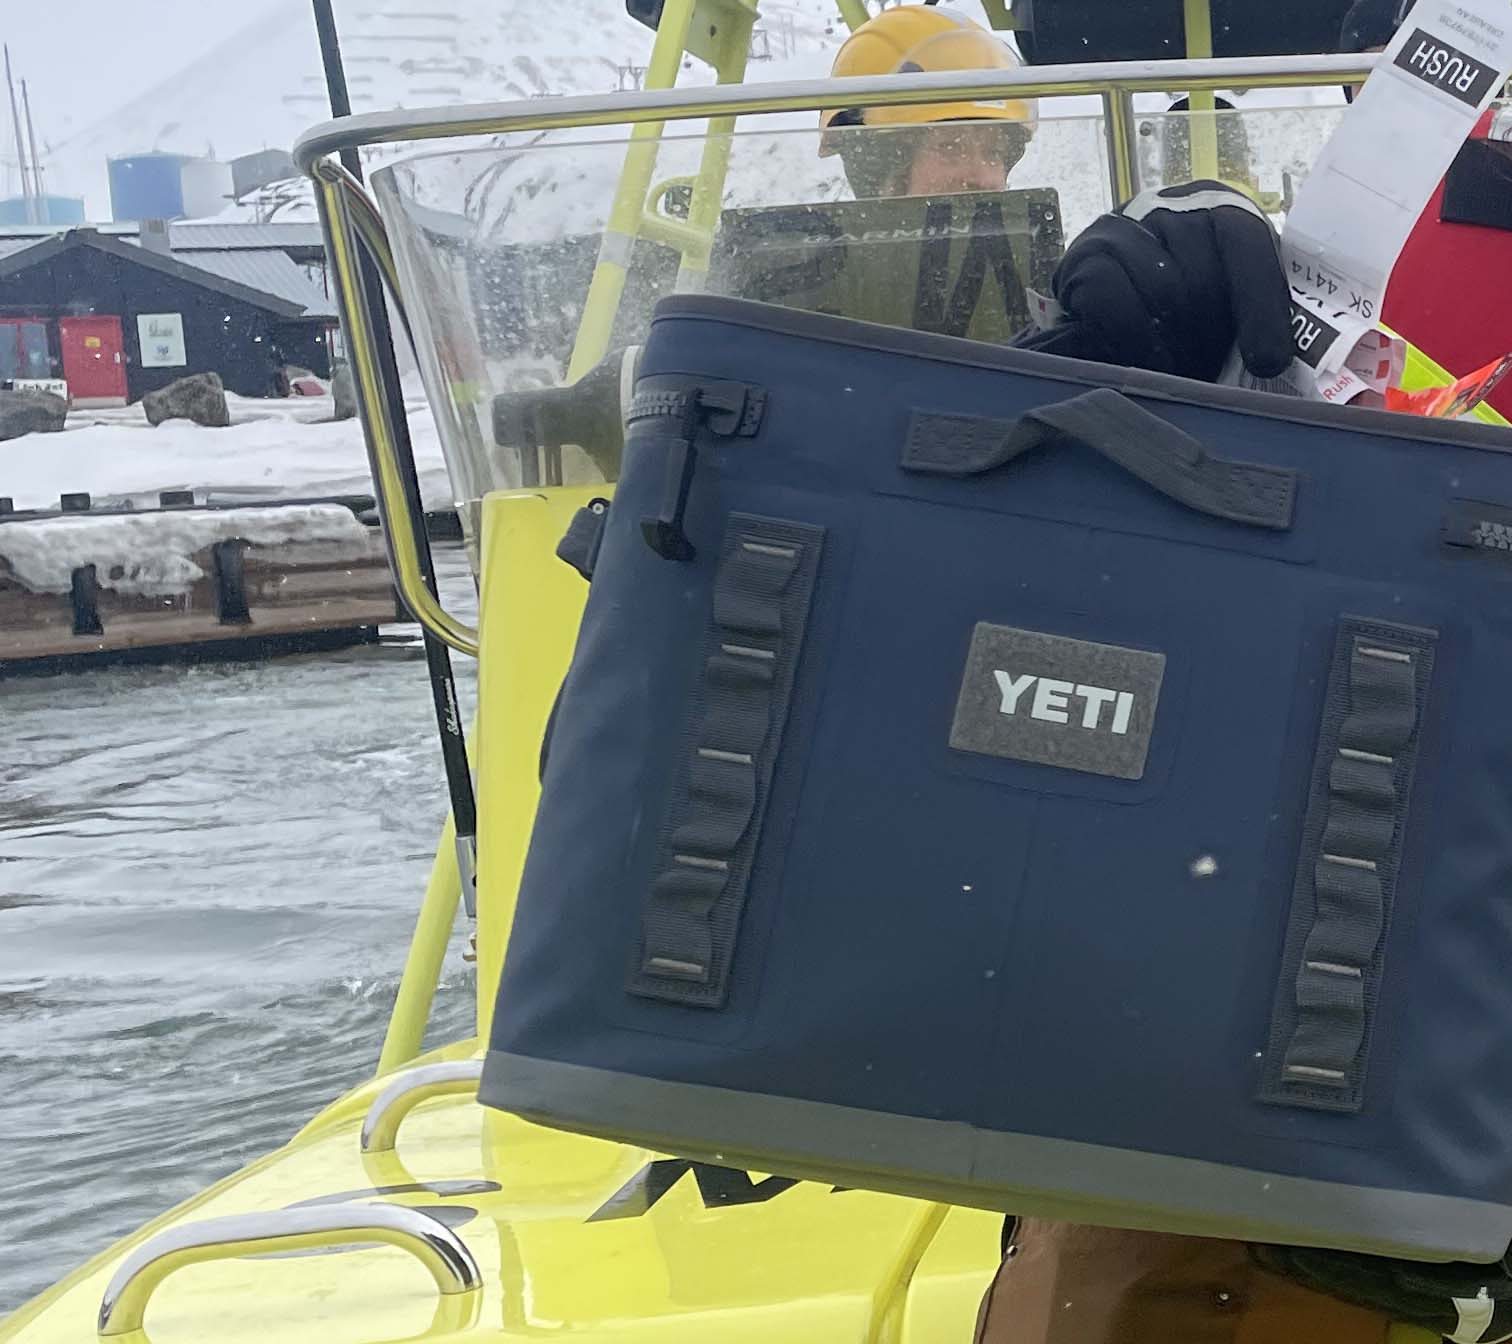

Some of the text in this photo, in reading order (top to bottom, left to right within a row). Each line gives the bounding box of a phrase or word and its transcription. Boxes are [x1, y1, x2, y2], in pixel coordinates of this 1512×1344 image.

[1409, 40, 1480, 92] RUSH
[1349, 291, 1374, 319] SK
[1289, 307, 1322, 352] RU
[1323, 375, 1354, 401] Rush
[993, 668, 1135, 735] YETI
